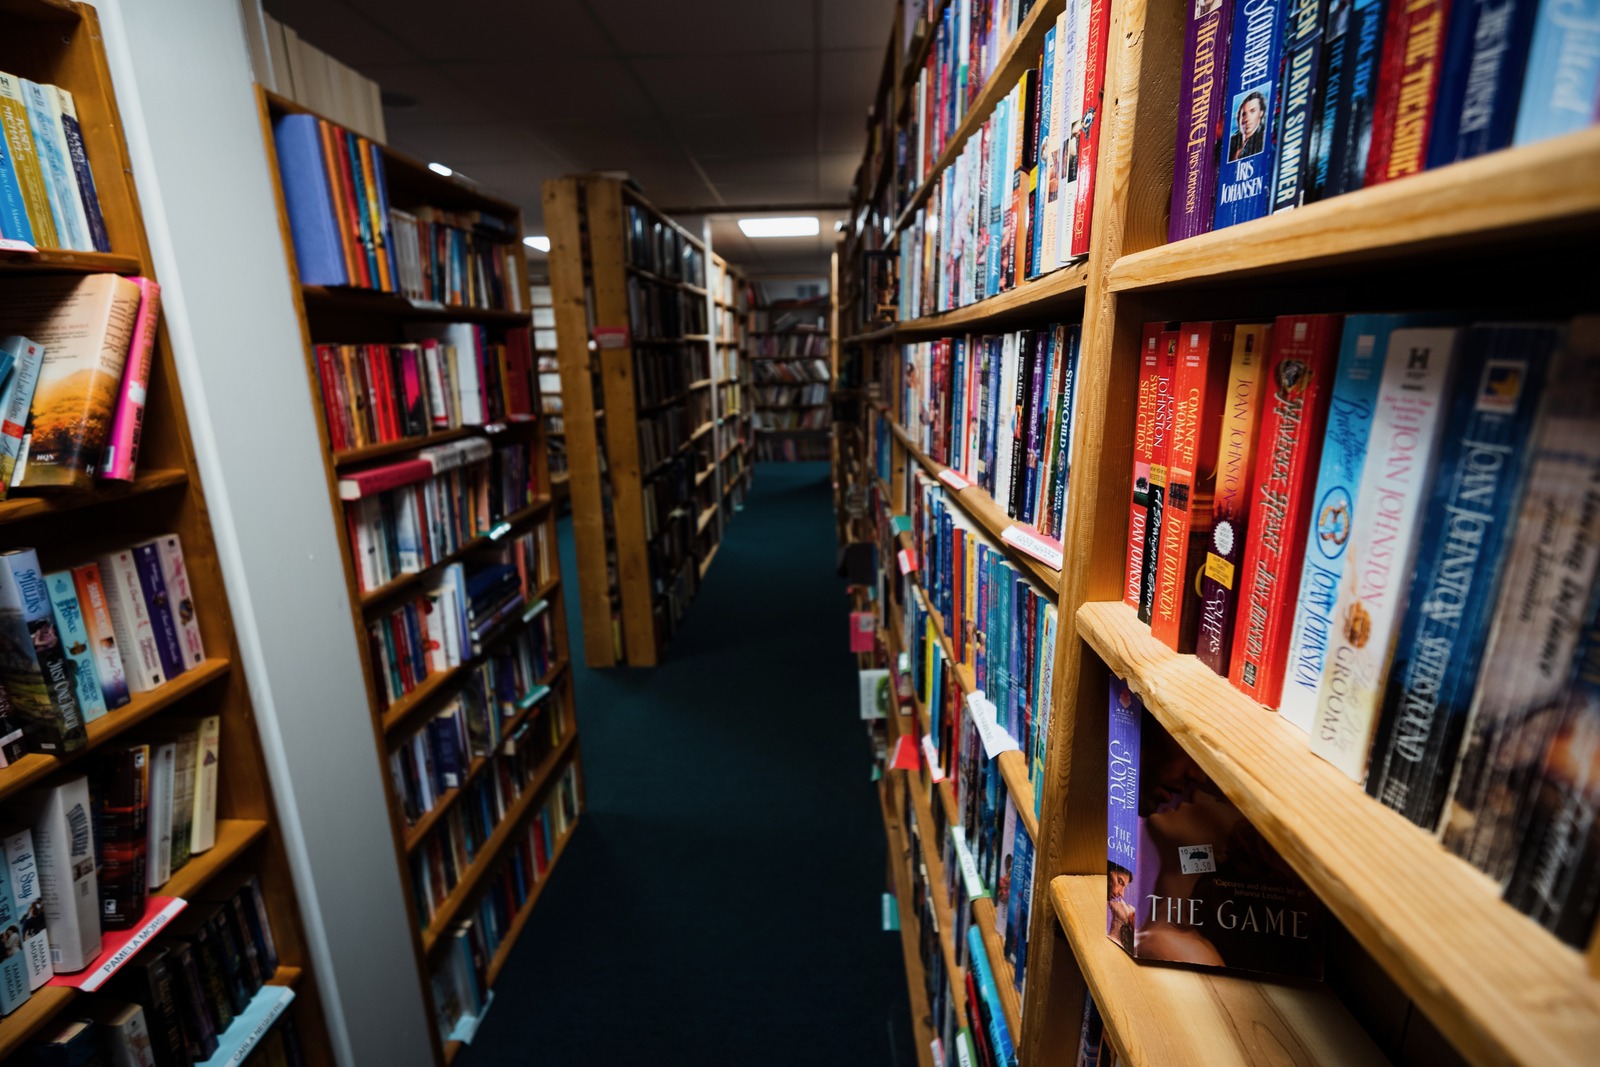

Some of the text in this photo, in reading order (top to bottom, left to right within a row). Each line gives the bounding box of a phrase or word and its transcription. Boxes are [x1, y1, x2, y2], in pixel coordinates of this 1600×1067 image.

[1086, 1, 1103, 101] MAIDENSONG
[1405, 10, 1443, 67] THE
[2, 104, 25, 161] MICHAELS
[16, 118, 32, 155] KASEY
[1186, 11, 1220, 214] TIGER PRINCE IRIS JOHANSEN
[1277, 47, 1313, 203] DARK SUMMER
[1032, 122, 1040, 162] GRIFFIN
[1220, 176, 1263, 206] JOHANSEN
[1235, 160, 1254, 182] IRIS
[1008, 211, 1018, 273] exposed
[1026, 194, 1035, 273] SNAPPED
[1074, 199, 1087, 241] GROE
[1063, 369, 1073, 408] STARRY
[1137, 380, 1149, 451] SEDUCTION
[1145, 375, 1158, 459] SWEETWATER
[1154, 377, 1169, 447] JOHNSTON
[1165, 393, 1175, 430] JOAN
[1060, 406, 1070, 448] CHILD
[1173, 401, 1188, 451] WOMAN
[1183, 388, 1200, 464] COMANCHE
[1224, 378, 1253, 500] JOAN JOHNSTON
[1271, 392, 1304, 486] MAVERICK
[1385, 422, 1421, 484] JOAN
[1458, 437, 1514, 503] JOAN
[1129, 509, 1145, 603] JOAN JOHNSTON
[1164, 514, 1181, 553] JOAN
[1361, 485, 1407, 608] JOHNSTON
[14, 569, 42, 614] MULLINS
[1160, 551, 1177, 621] JOHNSTON
[1307, 555, 1341, 615] JOAN
[1420, 503, 1495, 629] JOHNSTON
[1203, 600, 1215, 635] WIFE
[47, 658, 65, 685] JUST
[1294, 609, 1334, 694] JOHNSTON
[1405, 630, 1451, 704] SISTERS
[1320, 645, 1353, 744] GROOMS
[1396, 695, 1438, 764] FOUND
[1109, 740, 1131, 810] JOYCE
[1127, 766, 1137, 810] BRENDA
[1107, 836, 1136, 860] GAME
[1114, 826, 1131, 844] THE
[18, 871, 36, 899] Stay
[1183, 862, 1212, 872] $ 3.50
[103, 914, 169, 973] PAMELA MORSI
[1146, 894, 1309, 940] THE GAME
[3, 966, 16, 1001] MORGAN
[11, 963, 24, 996] TAMARA
[30, 941, 40, 976] MORGAN
[37, 940, 48, 970] TAMARA
[232, 1035, 257, 1062] CARLA
